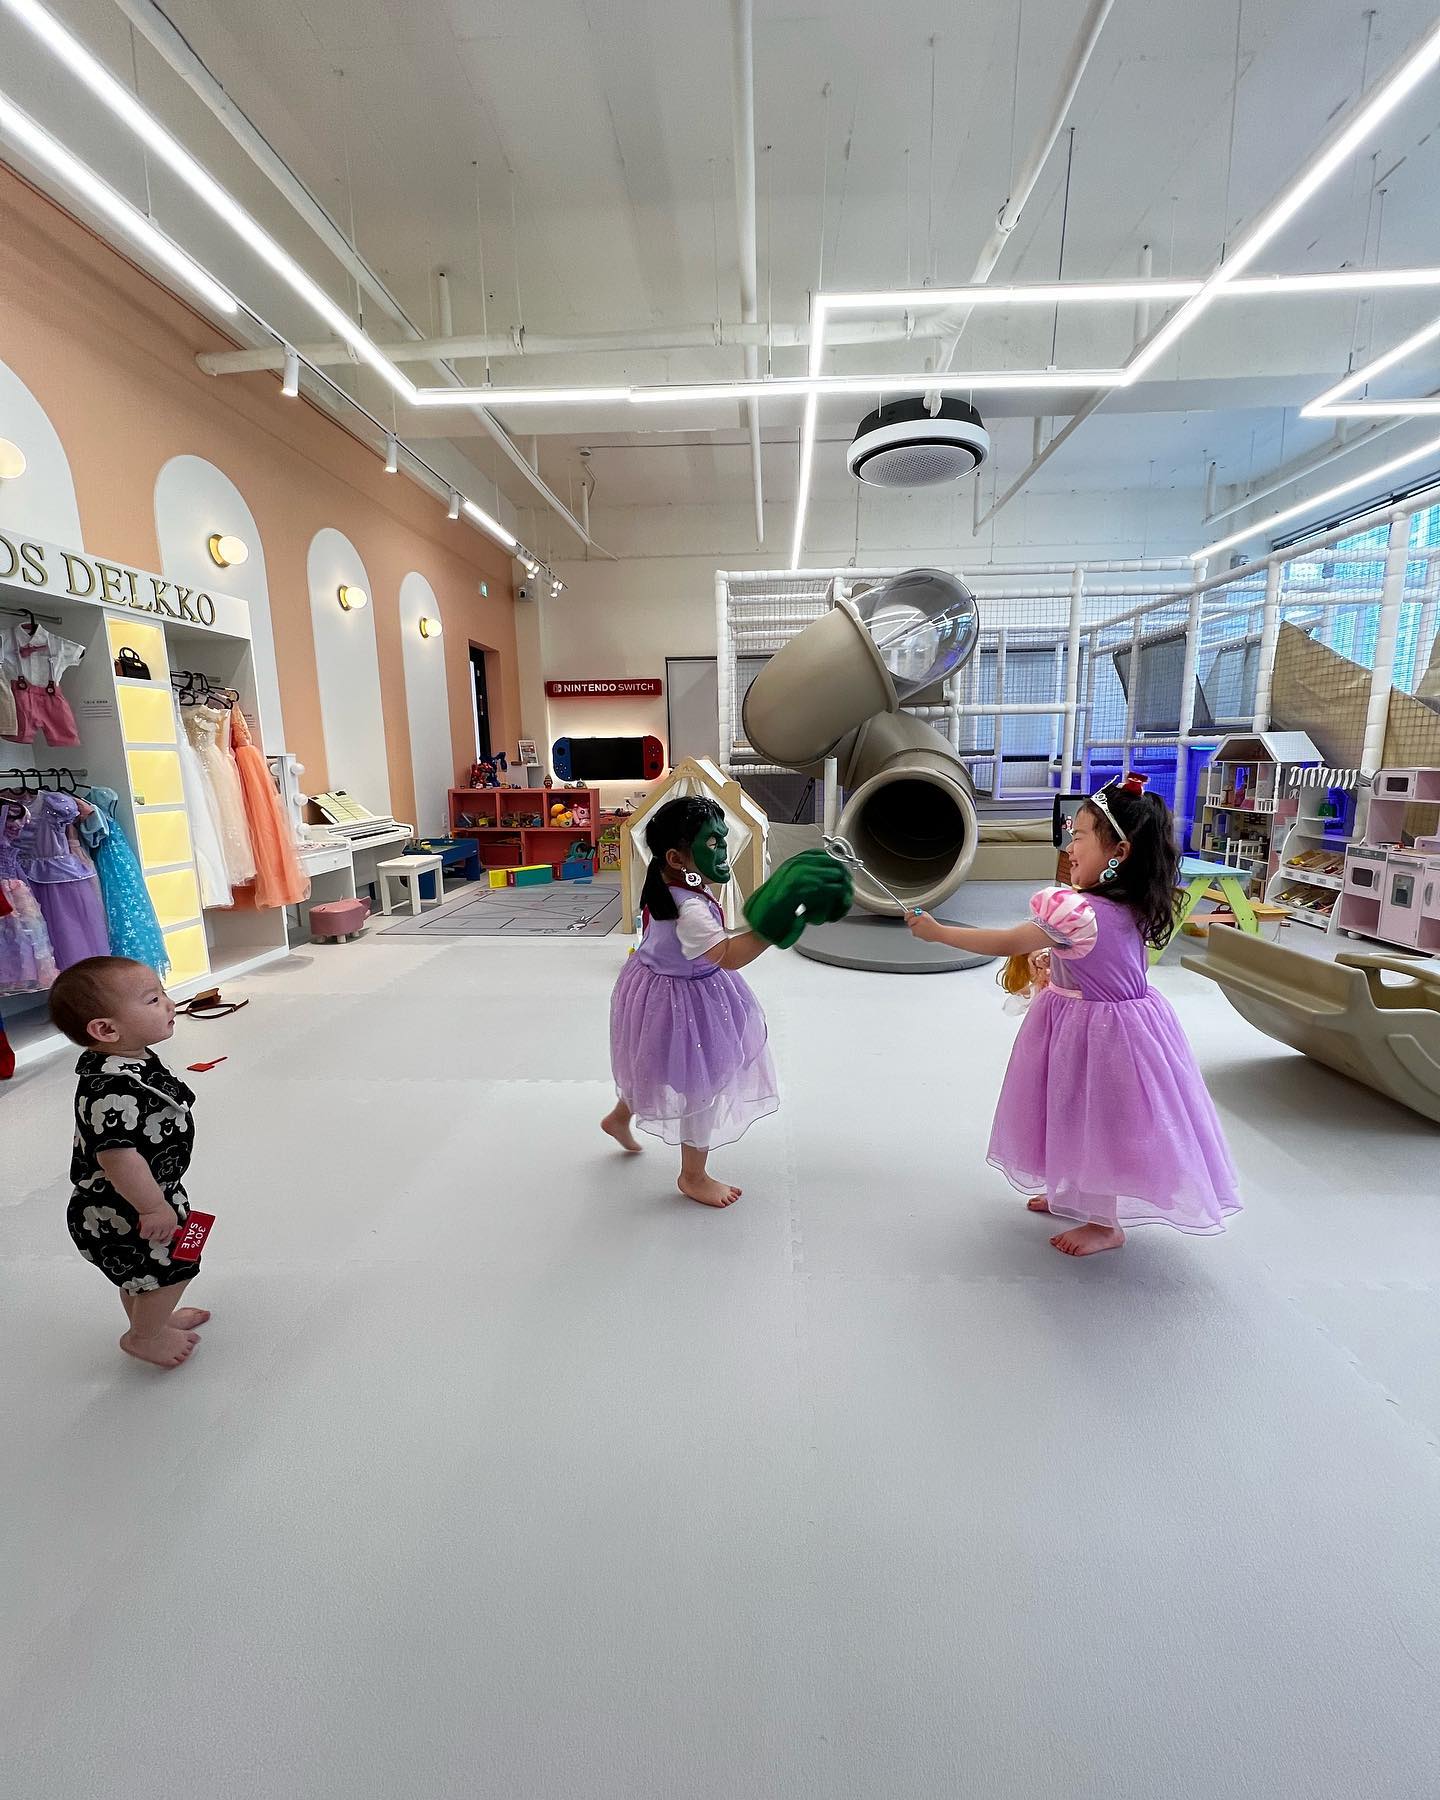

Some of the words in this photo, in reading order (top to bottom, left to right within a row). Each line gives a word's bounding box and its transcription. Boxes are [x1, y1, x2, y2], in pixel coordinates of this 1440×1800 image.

[60, 552, 216, 626] DELKKO
[563, 684, 616, 692] NINTENDO
[618, 683, 654, 691] SWITCH
[181, 1222, 198, 1249] SALE
[190, 1226, 206, 1248] 30%
